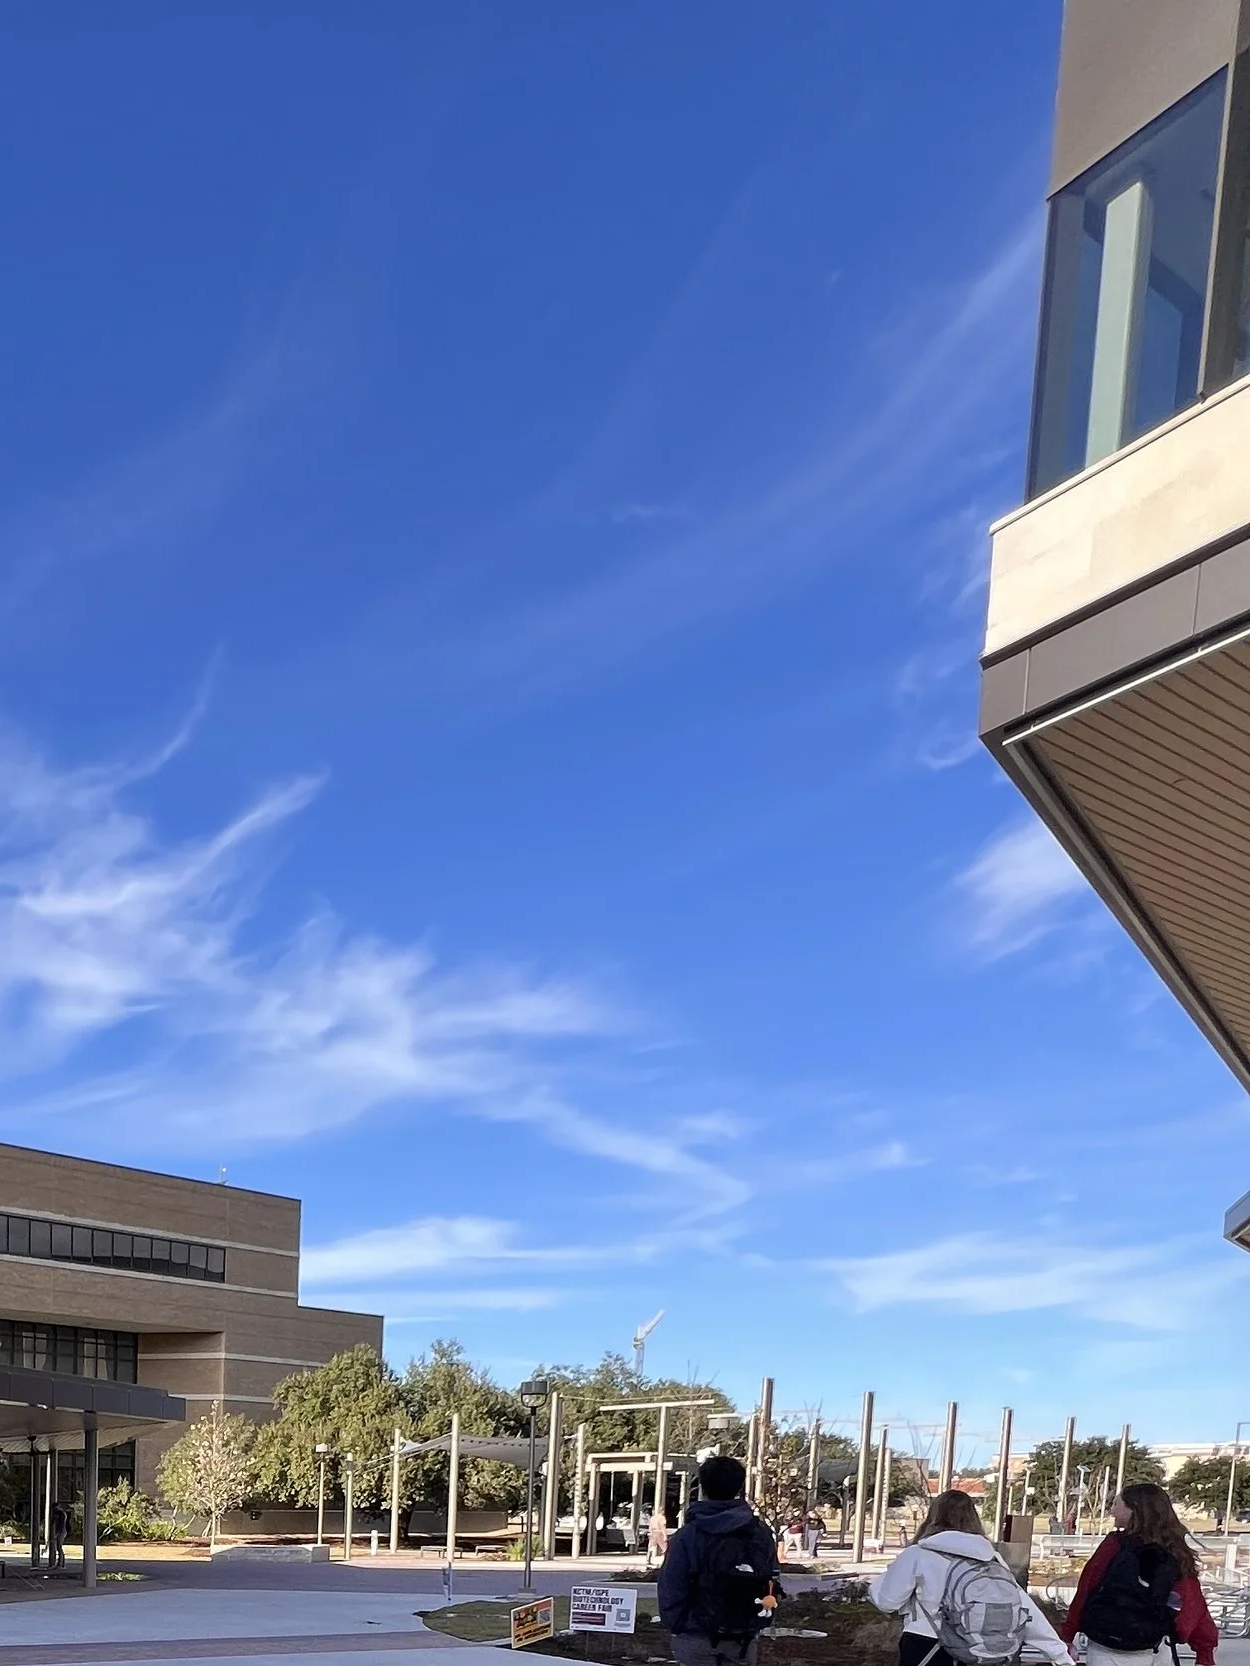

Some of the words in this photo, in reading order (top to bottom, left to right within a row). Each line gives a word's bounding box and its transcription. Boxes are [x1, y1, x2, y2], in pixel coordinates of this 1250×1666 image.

[573, 1596, 624, 1605] BIOTECHNOLOGY
[572, 1603, 596, 1611] CAREER
[598, 1604, 612, 1612] FAIR
